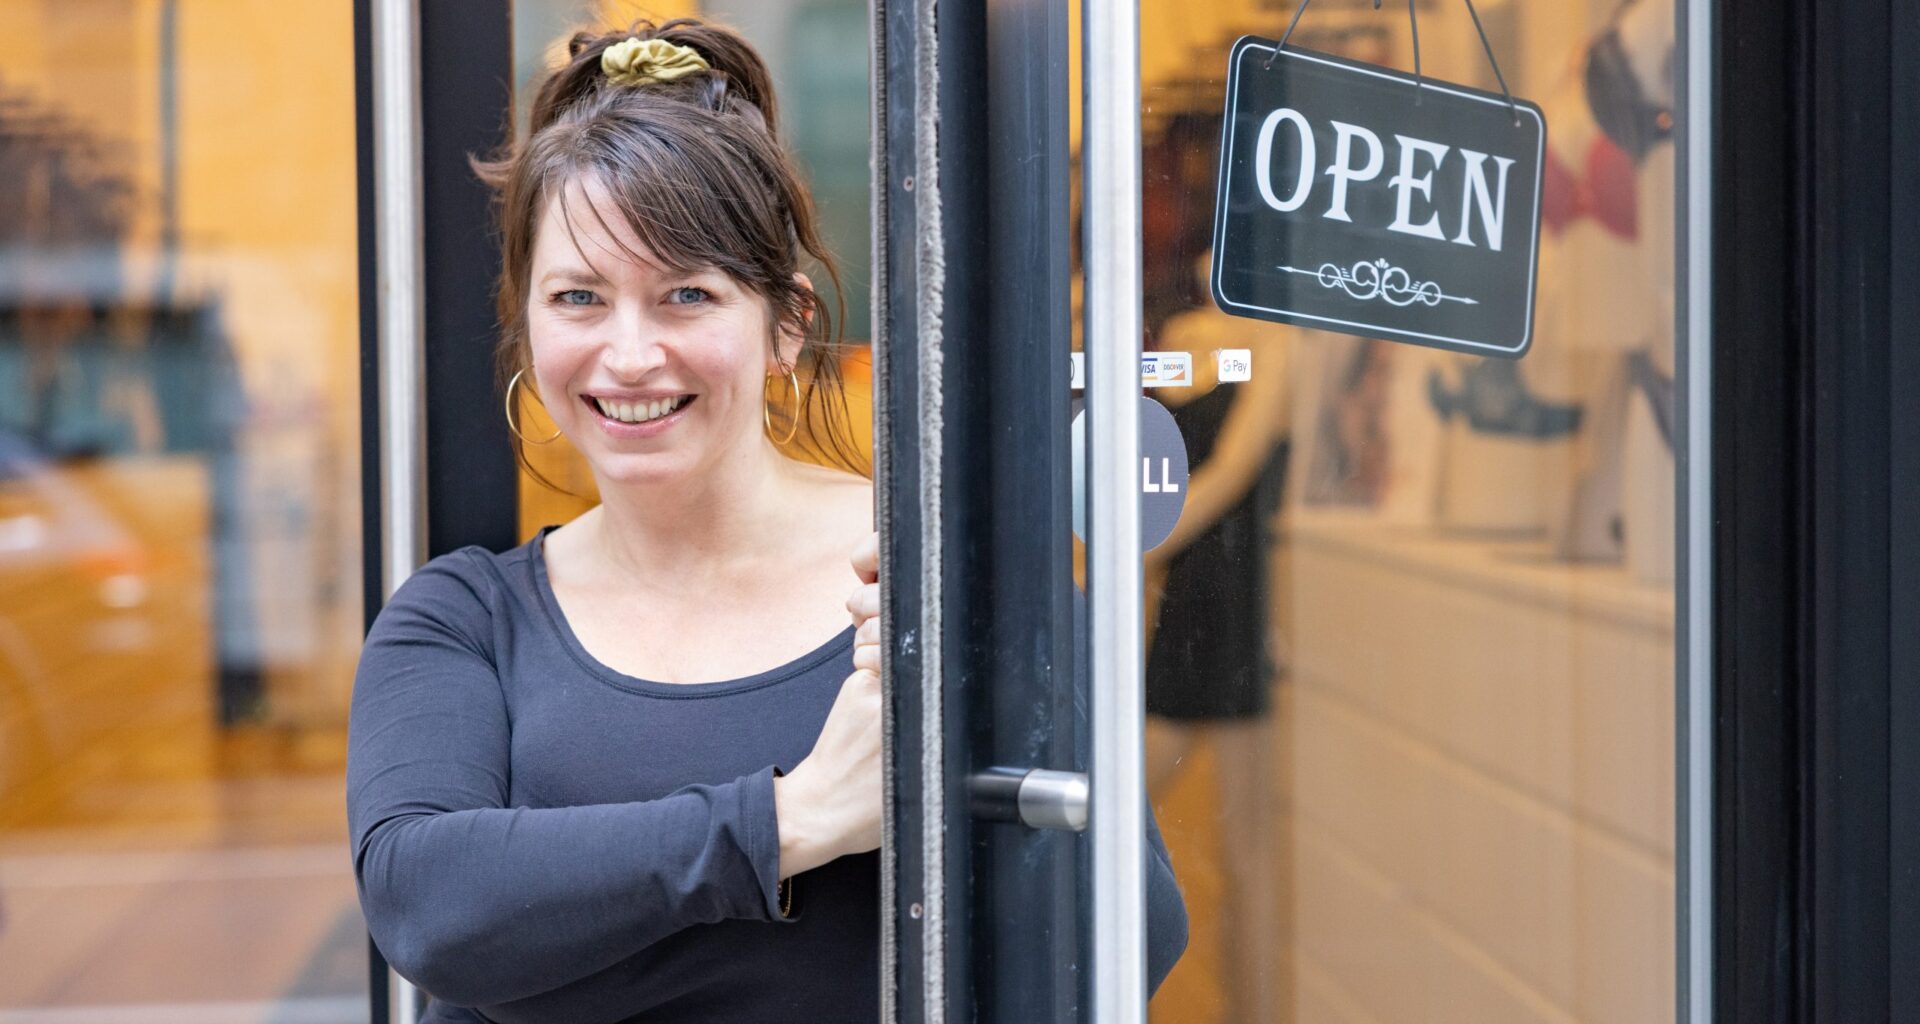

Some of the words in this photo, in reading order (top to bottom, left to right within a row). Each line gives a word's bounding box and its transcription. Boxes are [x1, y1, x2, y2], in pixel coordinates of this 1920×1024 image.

[1256, 108, 1516, 251] OPEN
[1233, 360, 1247, 374] Pay
[1143, 457, 1179, 492] LL
